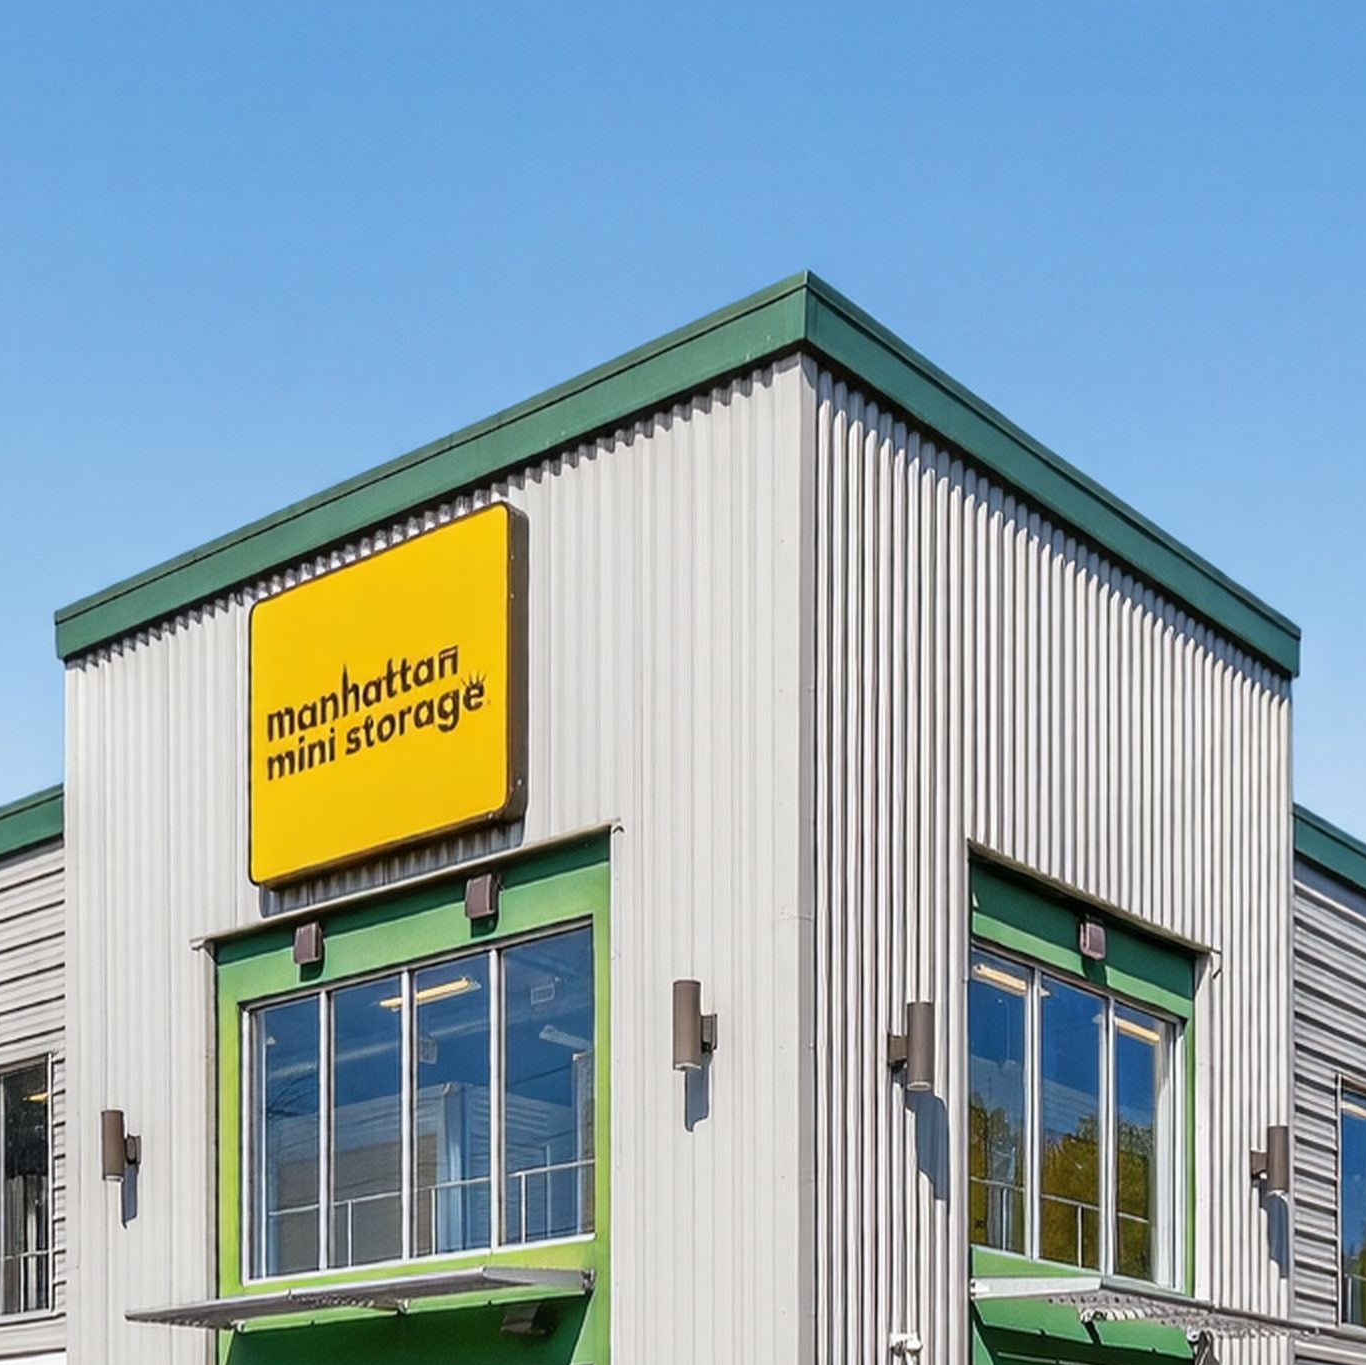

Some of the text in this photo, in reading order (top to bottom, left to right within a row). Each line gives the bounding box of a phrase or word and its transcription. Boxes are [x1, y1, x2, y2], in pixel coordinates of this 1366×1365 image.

[267, 645, 459, 742] manhattan
[267, 672, 486, 780] mini storage
